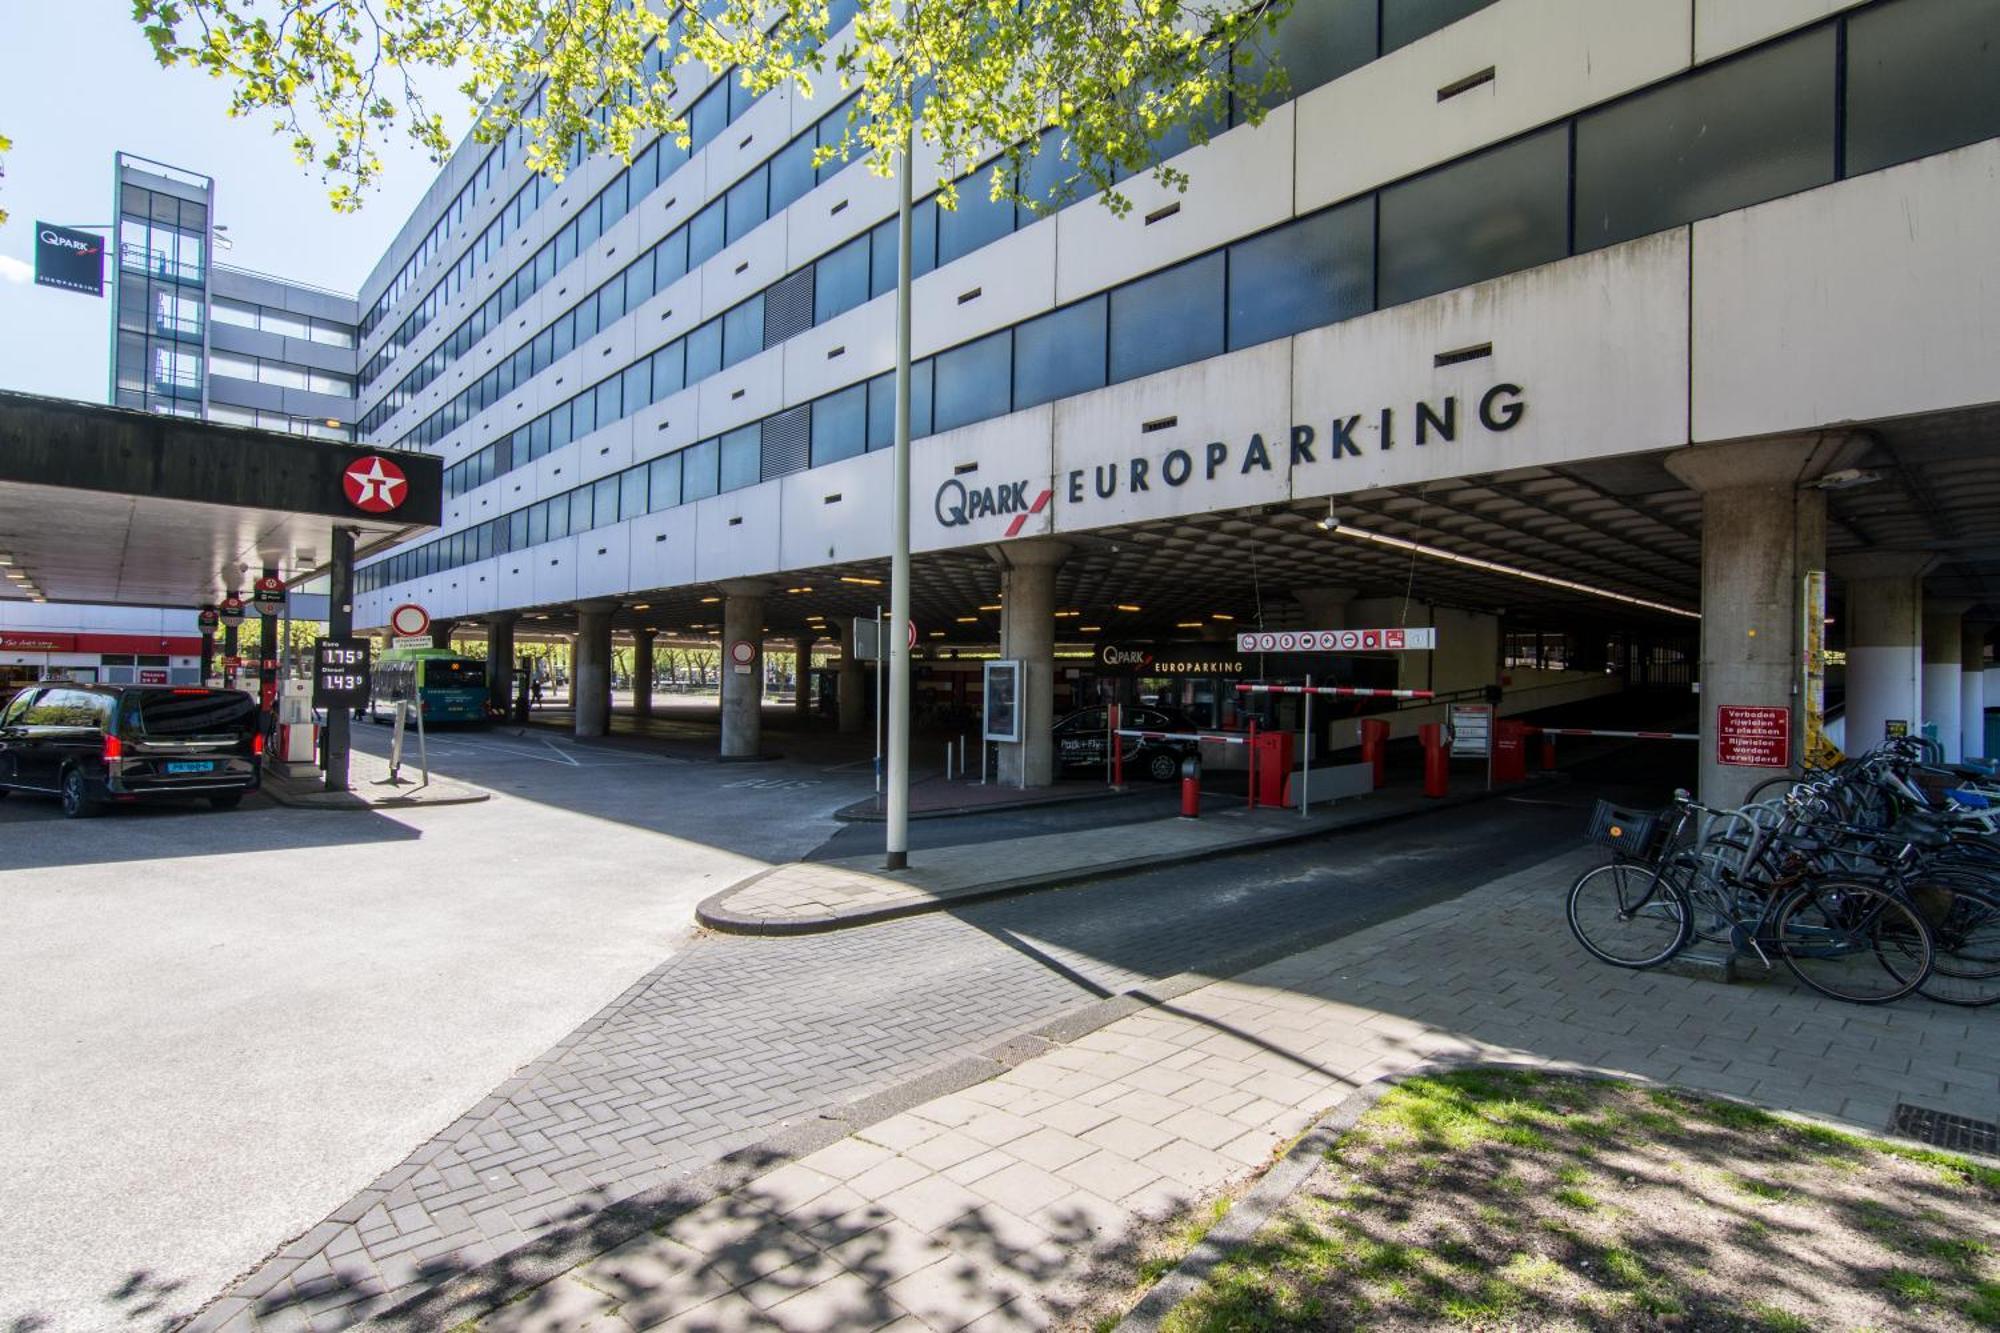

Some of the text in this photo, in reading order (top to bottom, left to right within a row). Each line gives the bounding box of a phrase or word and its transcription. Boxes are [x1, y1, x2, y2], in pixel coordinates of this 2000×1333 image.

[1068, 384, 1525, 503] EUROPARKING
[1155, 662, 1243, 673] EUROPARKING
[1728, 710, 1776, 718] Verboden
[1730, 718, 1773, 726] rijwielen
[1736, 727, 1780, 735] plaatsen
[1728, 738, 1775, 746] Rijwielen
[1733, 746, 1770, 755] worden
[1725, 754, 1778, 763] verwijderd
